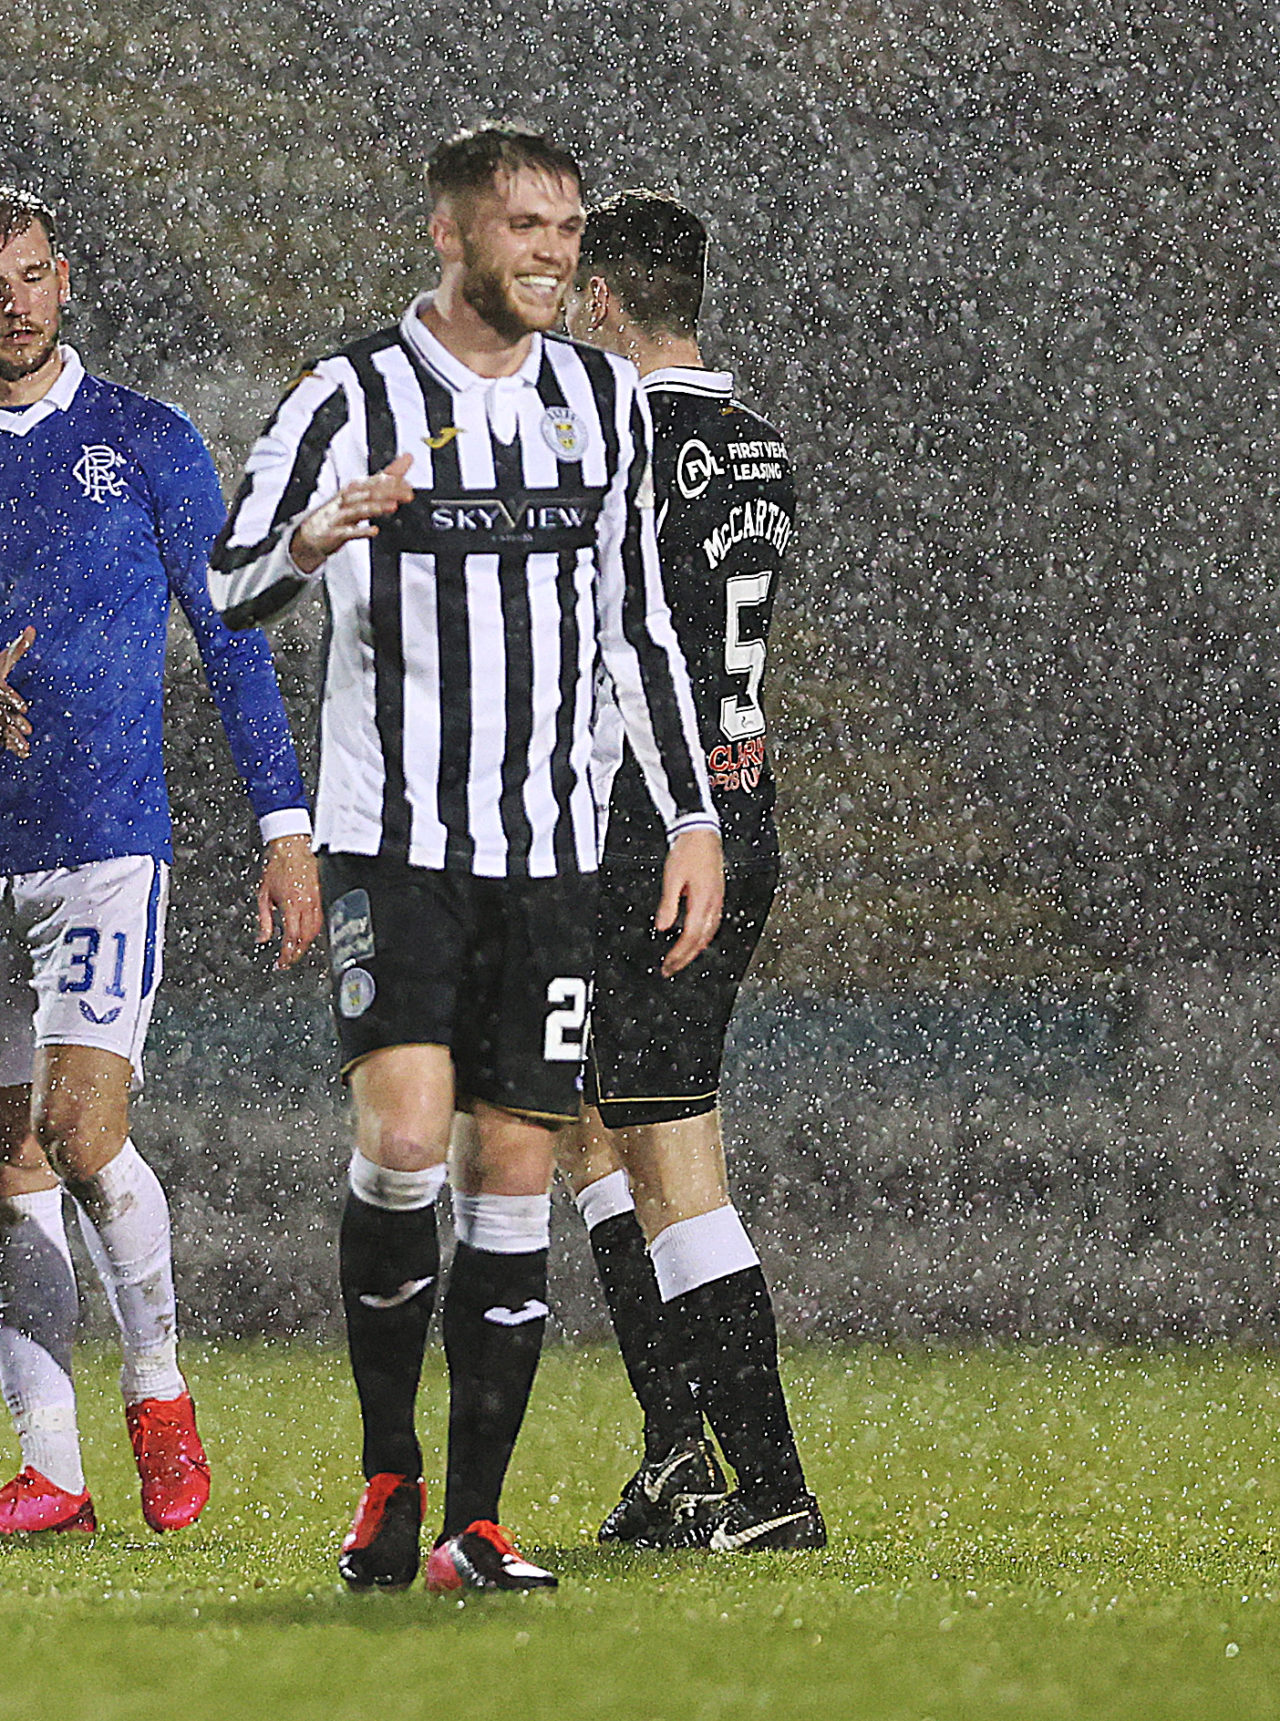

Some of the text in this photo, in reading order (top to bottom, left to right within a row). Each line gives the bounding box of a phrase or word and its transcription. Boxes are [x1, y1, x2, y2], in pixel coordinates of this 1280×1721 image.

[732, 462, 783, 481] LEASING
[720, 570, 772, 742] 5
[58, 927, 126, 999] 31
[544, 977, 594, 1061] 2
